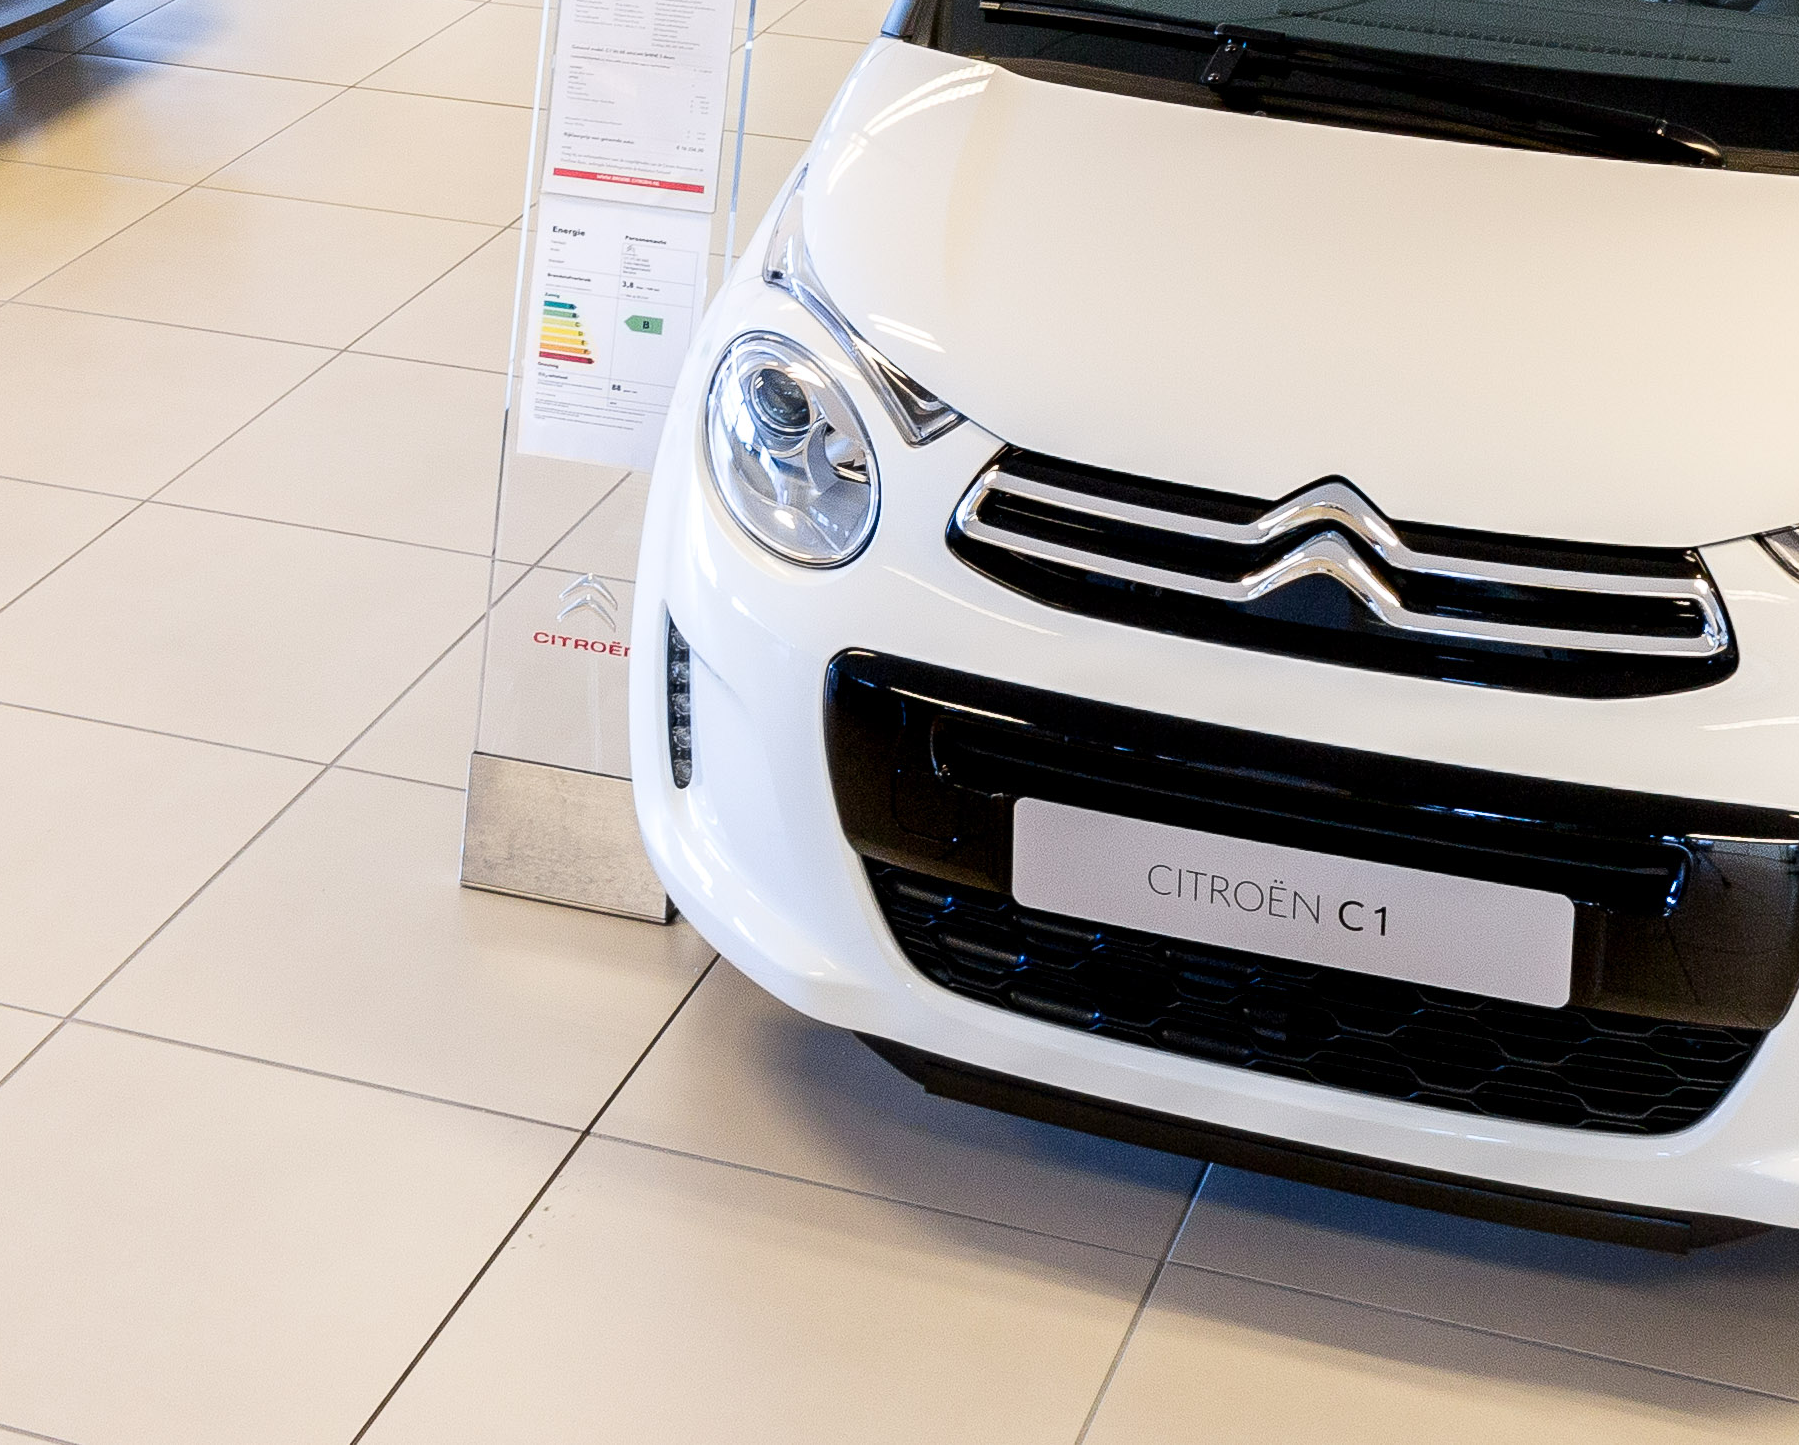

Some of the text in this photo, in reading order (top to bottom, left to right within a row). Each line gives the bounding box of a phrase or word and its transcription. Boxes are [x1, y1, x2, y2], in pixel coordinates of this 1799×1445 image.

[552, 225, 586, 237] Energie
[642, 320, 650, 330] B
[1147, 863, 1389, 937] CITROËN C1
